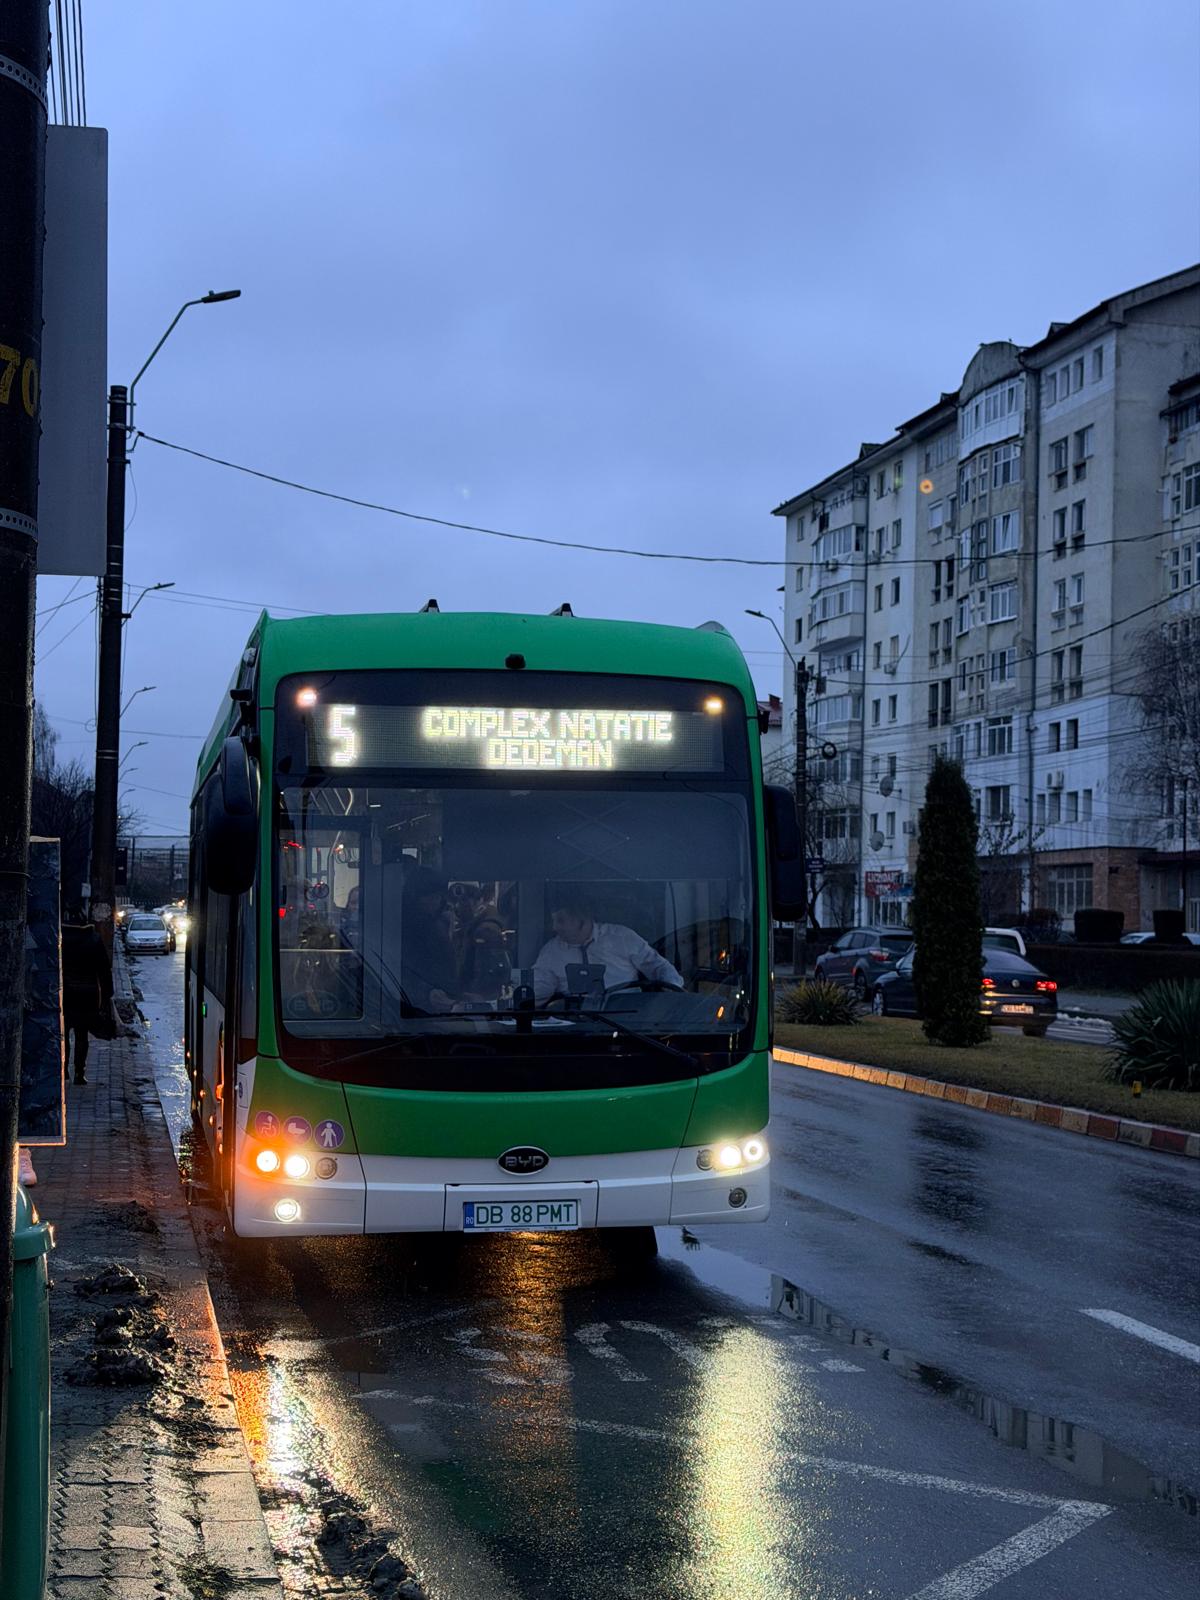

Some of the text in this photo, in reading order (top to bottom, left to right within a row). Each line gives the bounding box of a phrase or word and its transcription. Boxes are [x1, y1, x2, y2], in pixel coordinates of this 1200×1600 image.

[333, 706, 356, 764] 5
[424, 706, 674, 741] COMPLEX NATATIE
[486, 737, 614, 768] DEDEMAN
[505, 1155, 544, 1168] BYD
[476, 1203, 574, 1225] DB 88 PMT
